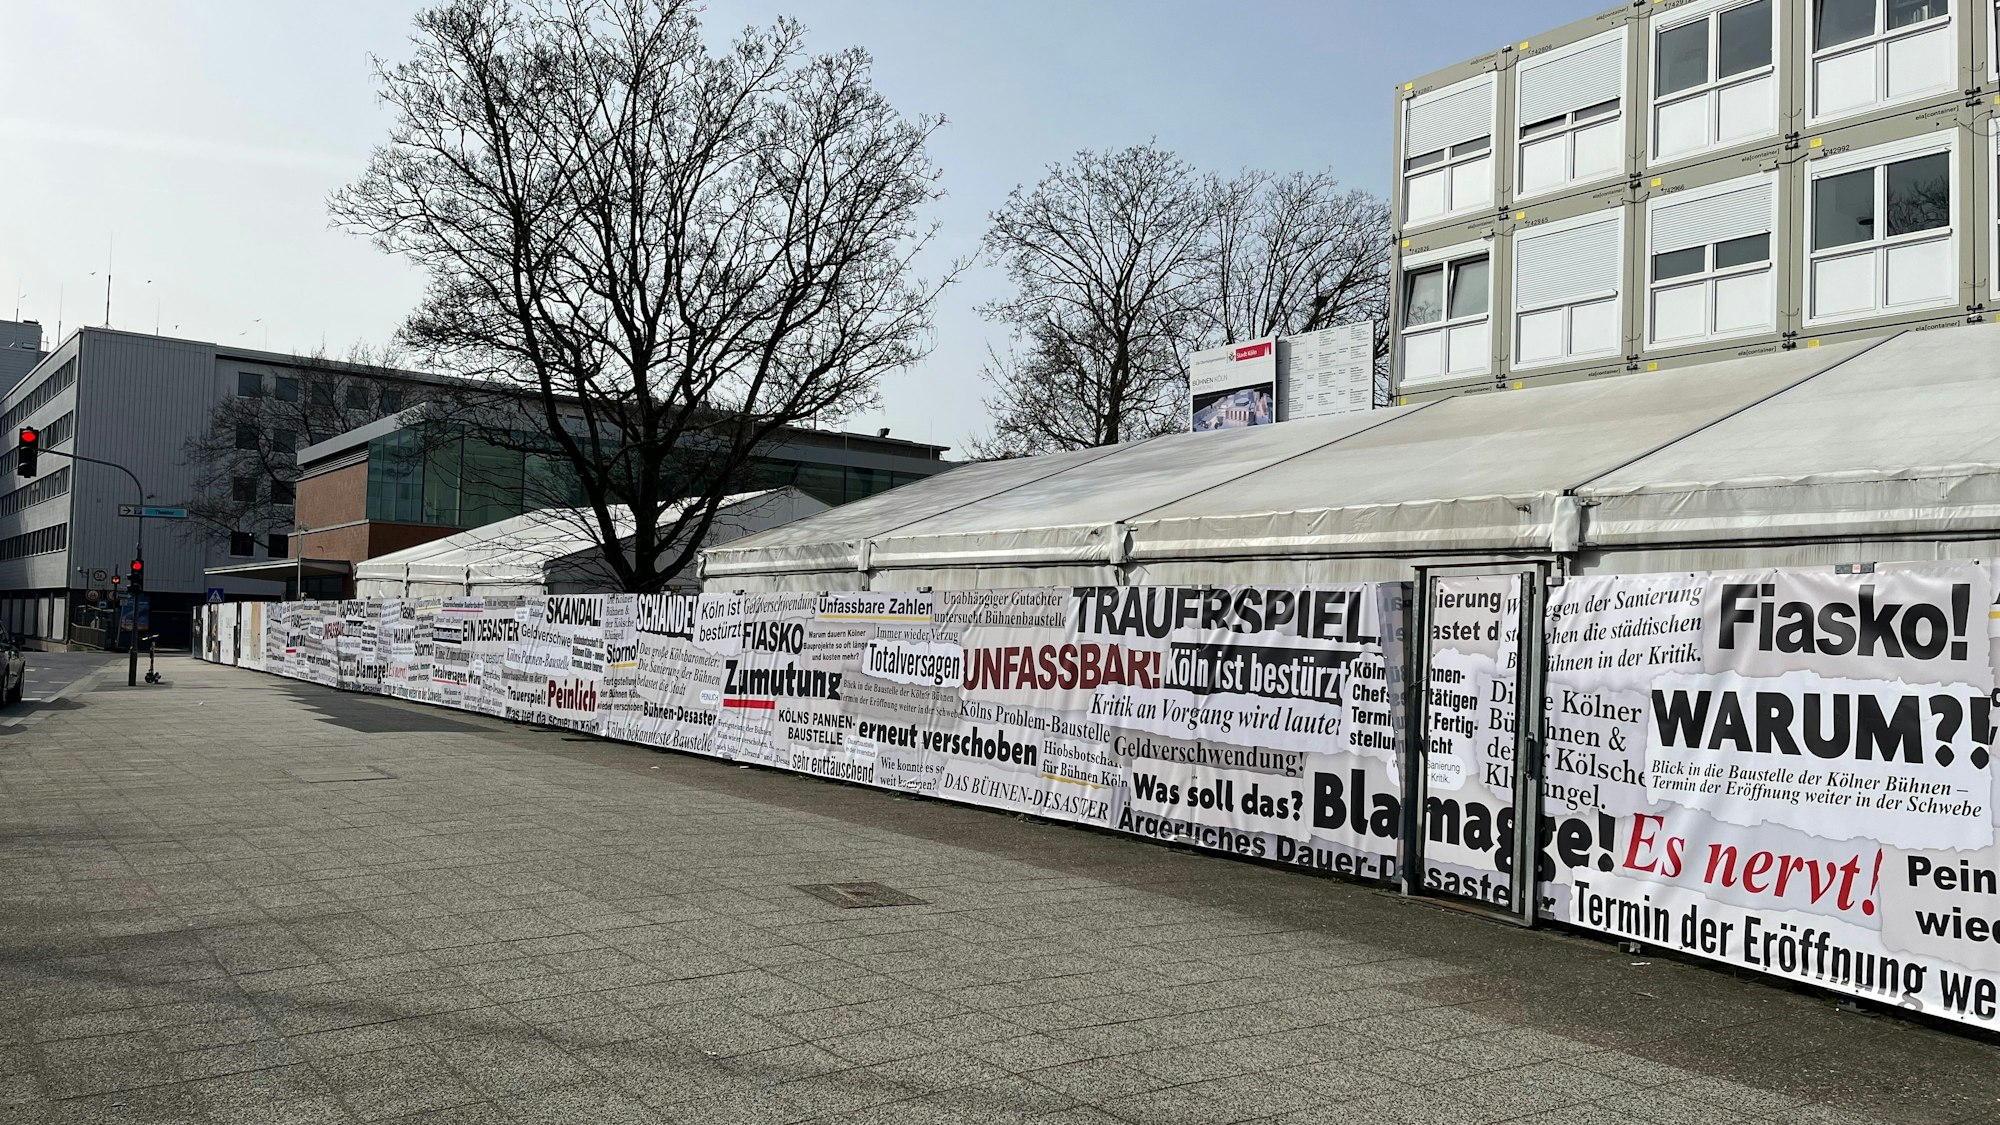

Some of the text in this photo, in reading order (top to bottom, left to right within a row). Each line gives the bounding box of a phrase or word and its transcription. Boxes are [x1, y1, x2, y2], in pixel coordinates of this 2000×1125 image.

[1915, 105, 1959, 121] ela[container]
[546, 596, 603, 627] SKANDAL!
[702, 598, 741, 620] Köln ist
[819, 598, 933, 615] Unfassbare Zahlen
[943, 590, 1063, 607] Unabhängiger Gutachter
[1434, 589, 1501, 613] ierung
[1585, 595, 1611, 613] der
[1614, 586, 1703, 610] Sanierung
[636, 593, 699, 634] SCHANDE!
[934, 610, 1067, 627] untersucht Bühnenbaustelle
[1073, 586, 1381, 645] TRAUERSPIEL
[1718, 583, 1971, 661] Fiasko!
[700, 620, 742, 641] bestürzt
[742, 621, 804, 654] FIASKO
[828, 630, 846, 638] dauern
[848, 629, 866, 637] Kölner
[876, 626, 958, 644] Immer wieder Verzug
[1433, 621, 1480, 640] astet
[1583, 615, 1702, 641] die städtischen
[606, 639, 639, 663] Storno!
[803, 642, 835, 651] Bauprojekte
[823, 653, 841, 661] kosten
[842, 653, 860, 661] mehr?
[1598, 650, 1613, 669] in
[1618, 648, 1643, 667] der
[1647, 643, 1702, 665] Kritik.
[682, 667, 692, 679] der
[693, 670, 720, 685] Bühnen
[869, 643, 960, 685] Totalversagen
[962, 642, 1161, 691] UNFASSBAR!
[1165, 648, 1351, 700] Köln ist bestürzt
[724, 659, 843, 700] Zumutung
[547, 679, 597, 712] Peinlich
[702, 693, 719, 701] PEINLICH
[1561, 690, 1642, 723] Kölner
[643, 701, 718, 726] Bühnen-Desaster
[778, 709, 856, 729] KÖLNS PANNEN-
[960, 700, 1110, 743] Kölns Problem-Baustelle
[1091, 693, 1280, 734] Kritik an Vorgang wird
[1434, 712, 1478, 738] Fertig-
[788, 727, 843, 745] BAUSTELLE
[858, 719, 918, 749] erneut
[922, 726, 1037, 766] verschoben
[1609, 726, 1627, 751] &
[1652, 689, 1991, 769] WARUM?!
[792, 751, 809, 772] sehr
[812, 756, 874, 783] enttäuschend
[880, 757, 895, 771] Wie
[897, 758, 923, 773] konnte
[925, 764, 934, 774] es
[1114, 735, 1304, 776] Geldverschwendung!
[1555, 747, 1646, 786] Kölsche
[880, 775, 897, 787] weit
[1042, 758, 1059, 774] für
[1060, 762, 1098, 784] Bühnen
[1652, 759, 1951, 796] Blick in die Baustelle der Kölner Bühnen
[944, 773, 1108, 820] DAS BÜHNEN-DESASTER
[1133, 772, 1303, 821] Was soll das?
[1652, 776, 1982, 819] Termin der Eröffnung weiter in der Schwebe
[1119, 802, 1266, 857] Ärgerliches
[1621, 813, 1882, 917] Es nervt!
[1574, 881, 1671, 943] Termin
[1680, 903, 1733, 957] der
[1743, 919, 1928, 1012] Eröffnung
